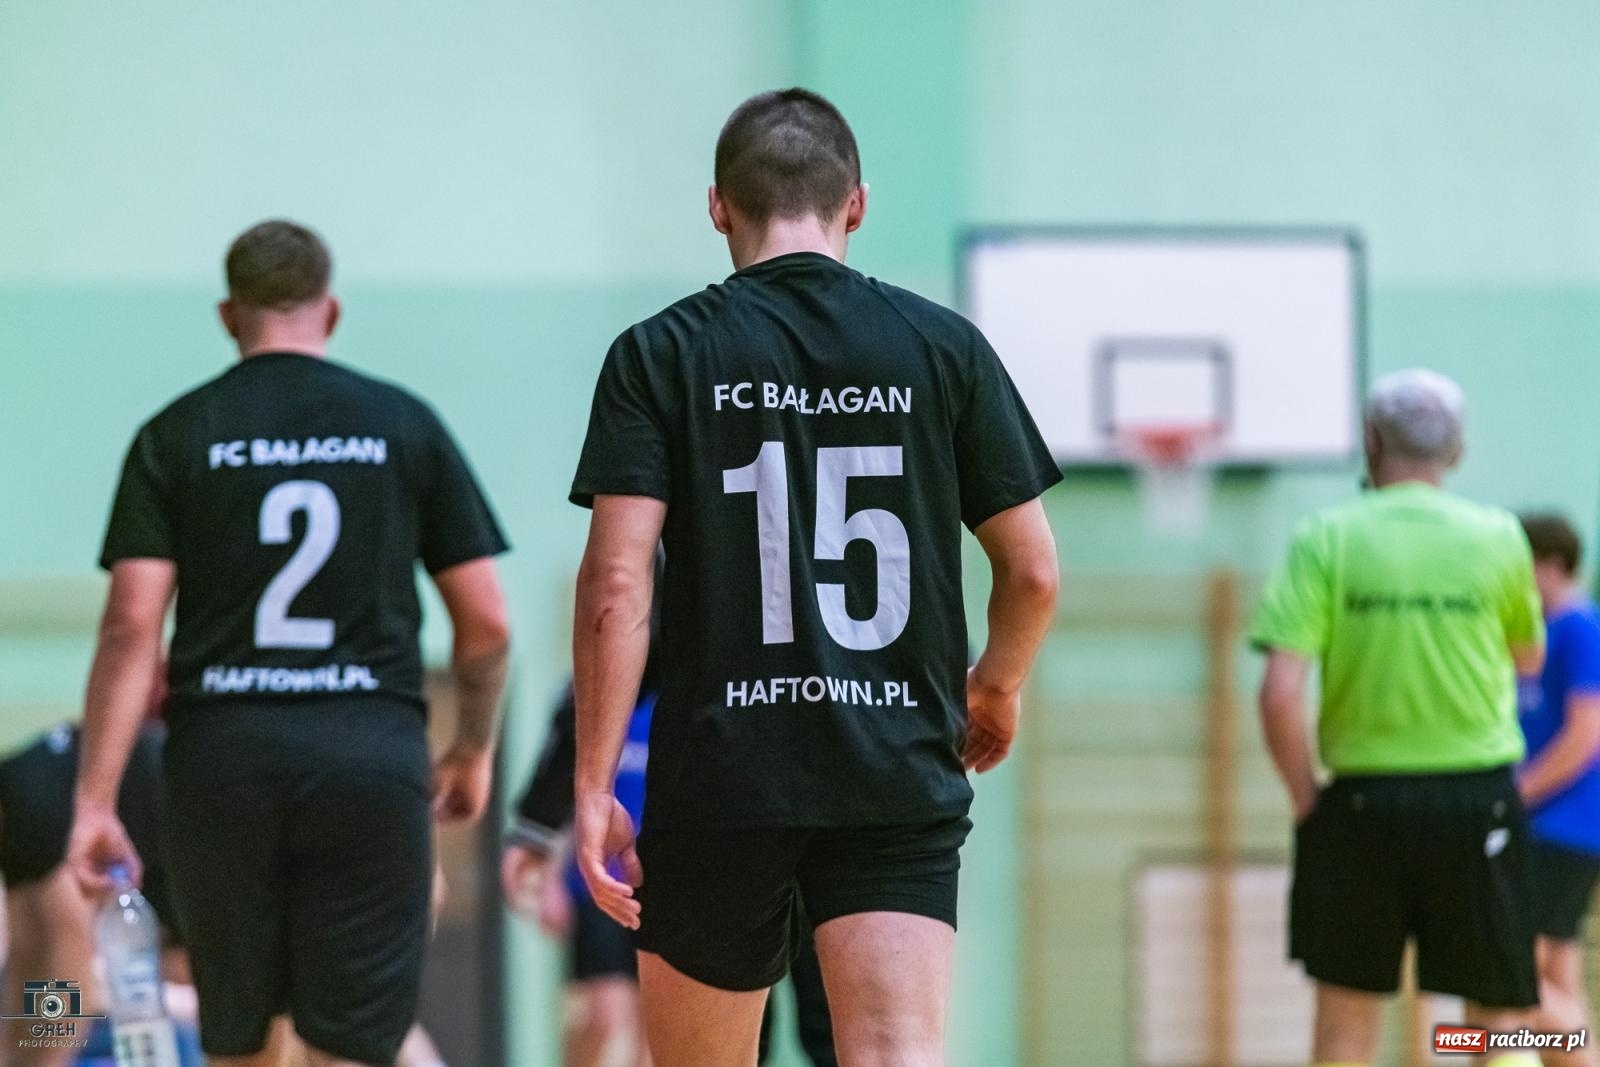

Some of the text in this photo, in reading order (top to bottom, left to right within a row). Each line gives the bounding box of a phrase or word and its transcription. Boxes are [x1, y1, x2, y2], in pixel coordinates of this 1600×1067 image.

[713, 382, 912, 414] FC BAŁAGAN
[208, 440, 247, 469] FC
[722, 441, 911, 651] 15
[255, 478, 342, 649] 2
[726, 675, 918, 707] HAFTOWN.PL
